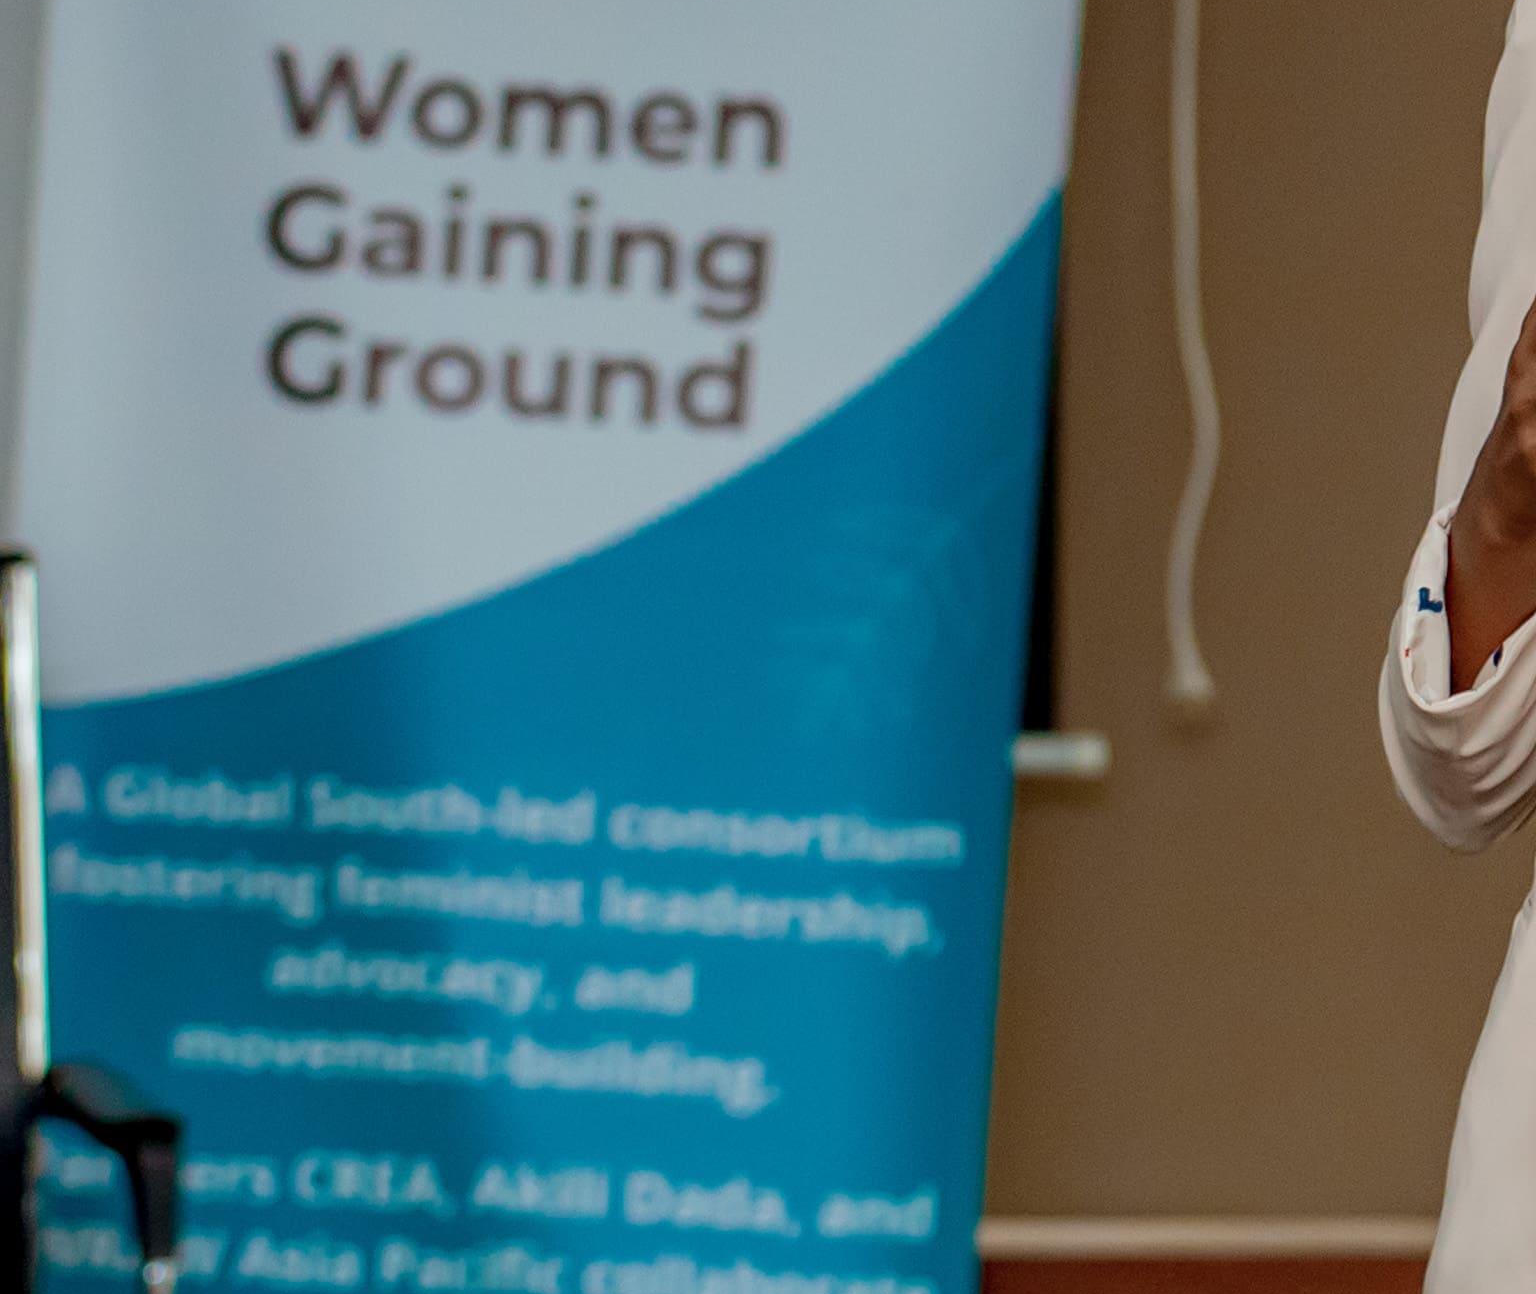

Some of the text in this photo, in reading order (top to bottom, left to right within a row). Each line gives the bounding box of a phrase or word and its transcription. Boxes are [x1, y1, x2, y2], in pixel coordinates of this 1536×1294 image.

[269, 45, 785, 171] Women
[262, 182, 772, 326] Gaining
[264, 314, 757, 433] Ground
[42, 763, 962, 865] A Global South-led consortium
[46, 841, 317, 922] fostering
[336, 863, 586, 929] feminist
[270, 948, 696, 1017] advocacy, and
[471, 1164, 612, 1219] Akili
[621, 1168, 800, 1237] Dada,
[815, 1192, 935, 1239] and
[236, 1234, 362, 1288] Asia
